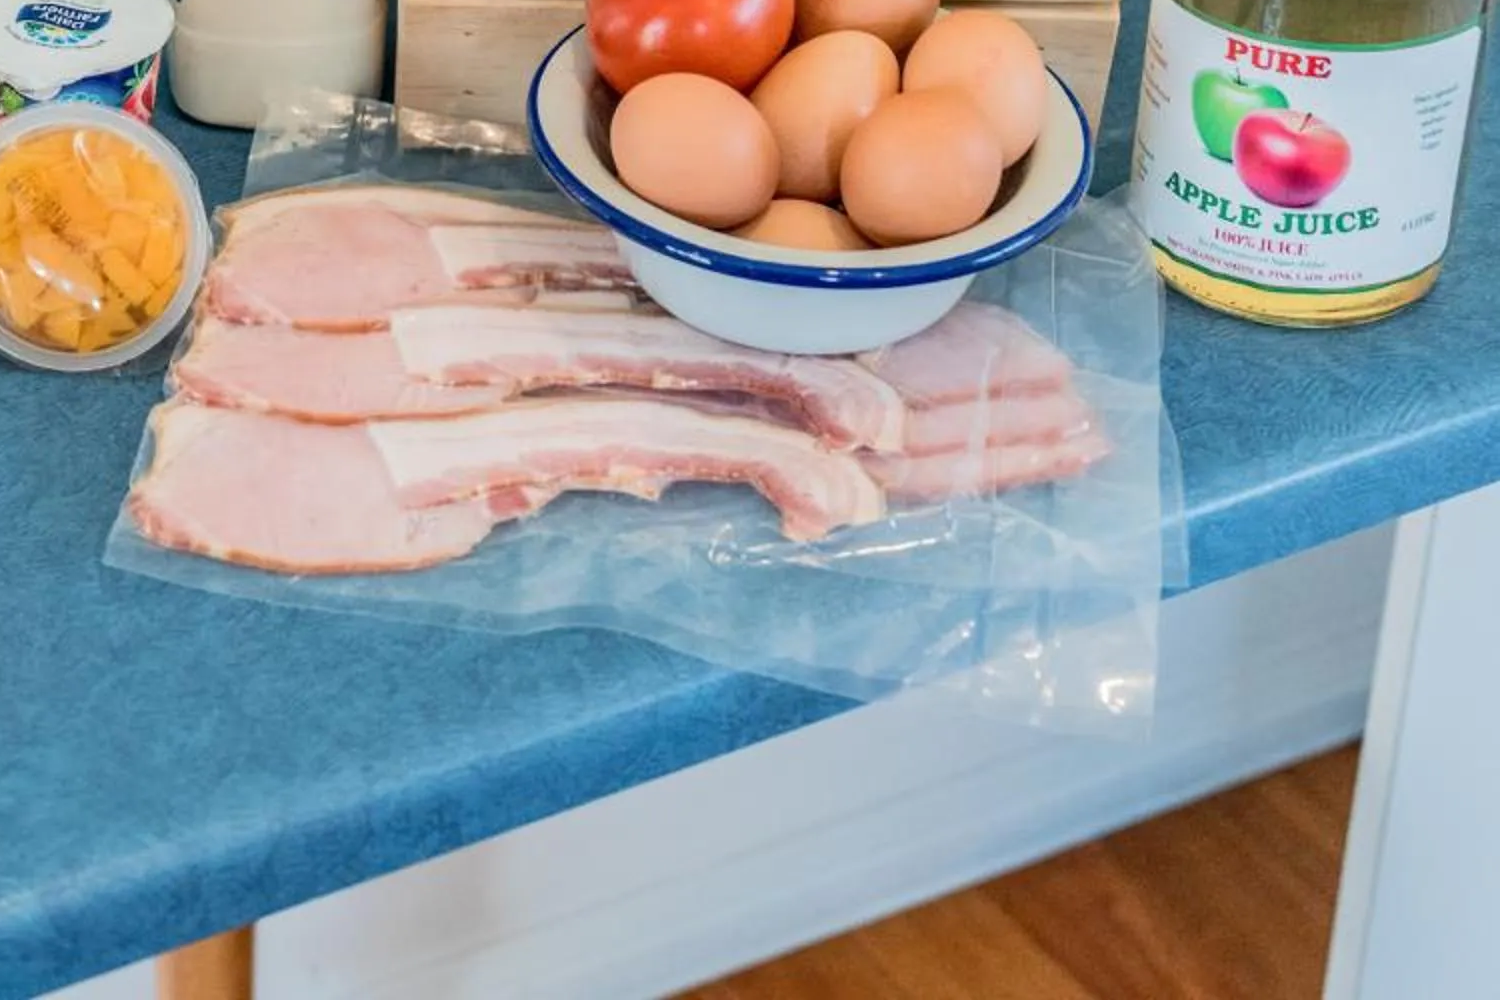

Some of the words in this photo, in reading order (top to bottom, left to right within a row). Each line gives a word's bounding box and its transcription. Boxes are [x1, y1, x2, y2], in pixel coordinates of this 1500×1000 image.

[39, 11, 86, 30] Dairy
[1224, 36, 1333, 79] PURE
[1164, 170, 1263, 229] APPLE
[1273, 206, 1381, 236] JUICE
[1213, 227, 1256, 249] 100%
[1259, 238, 1311, 257] JUICE
